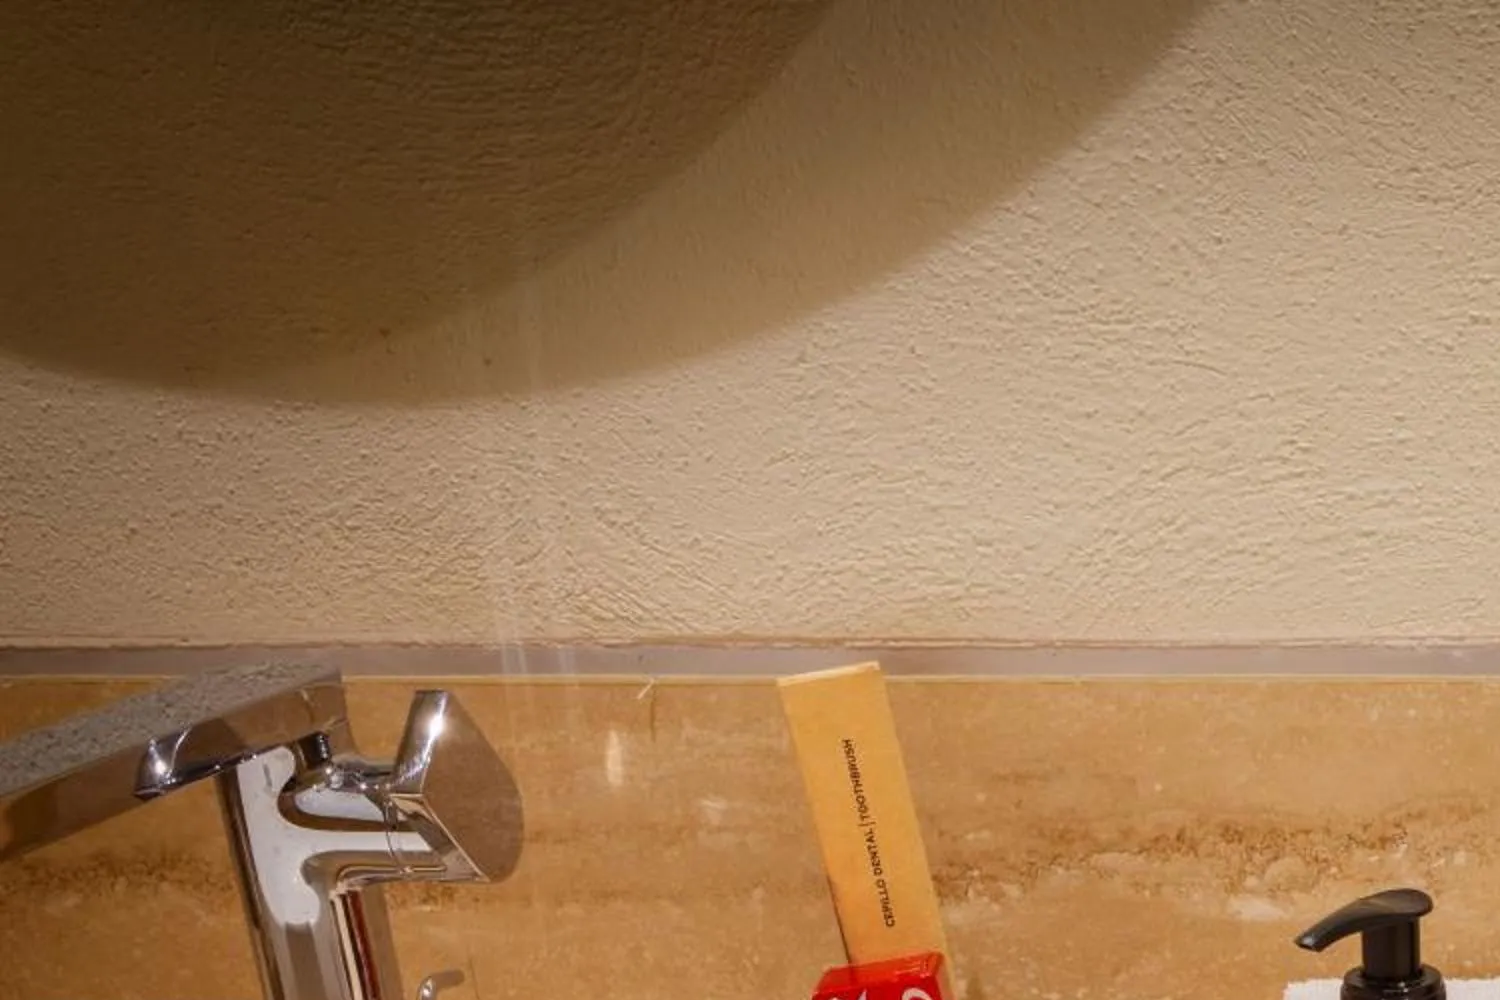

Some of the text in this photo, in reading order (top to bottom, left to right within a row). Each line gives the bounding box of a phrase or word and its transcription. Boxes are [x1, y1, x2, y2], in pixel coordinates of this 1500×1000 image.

[843, 739, 895, 927] CEPILLO DENTAL TOOTHBRUSH
